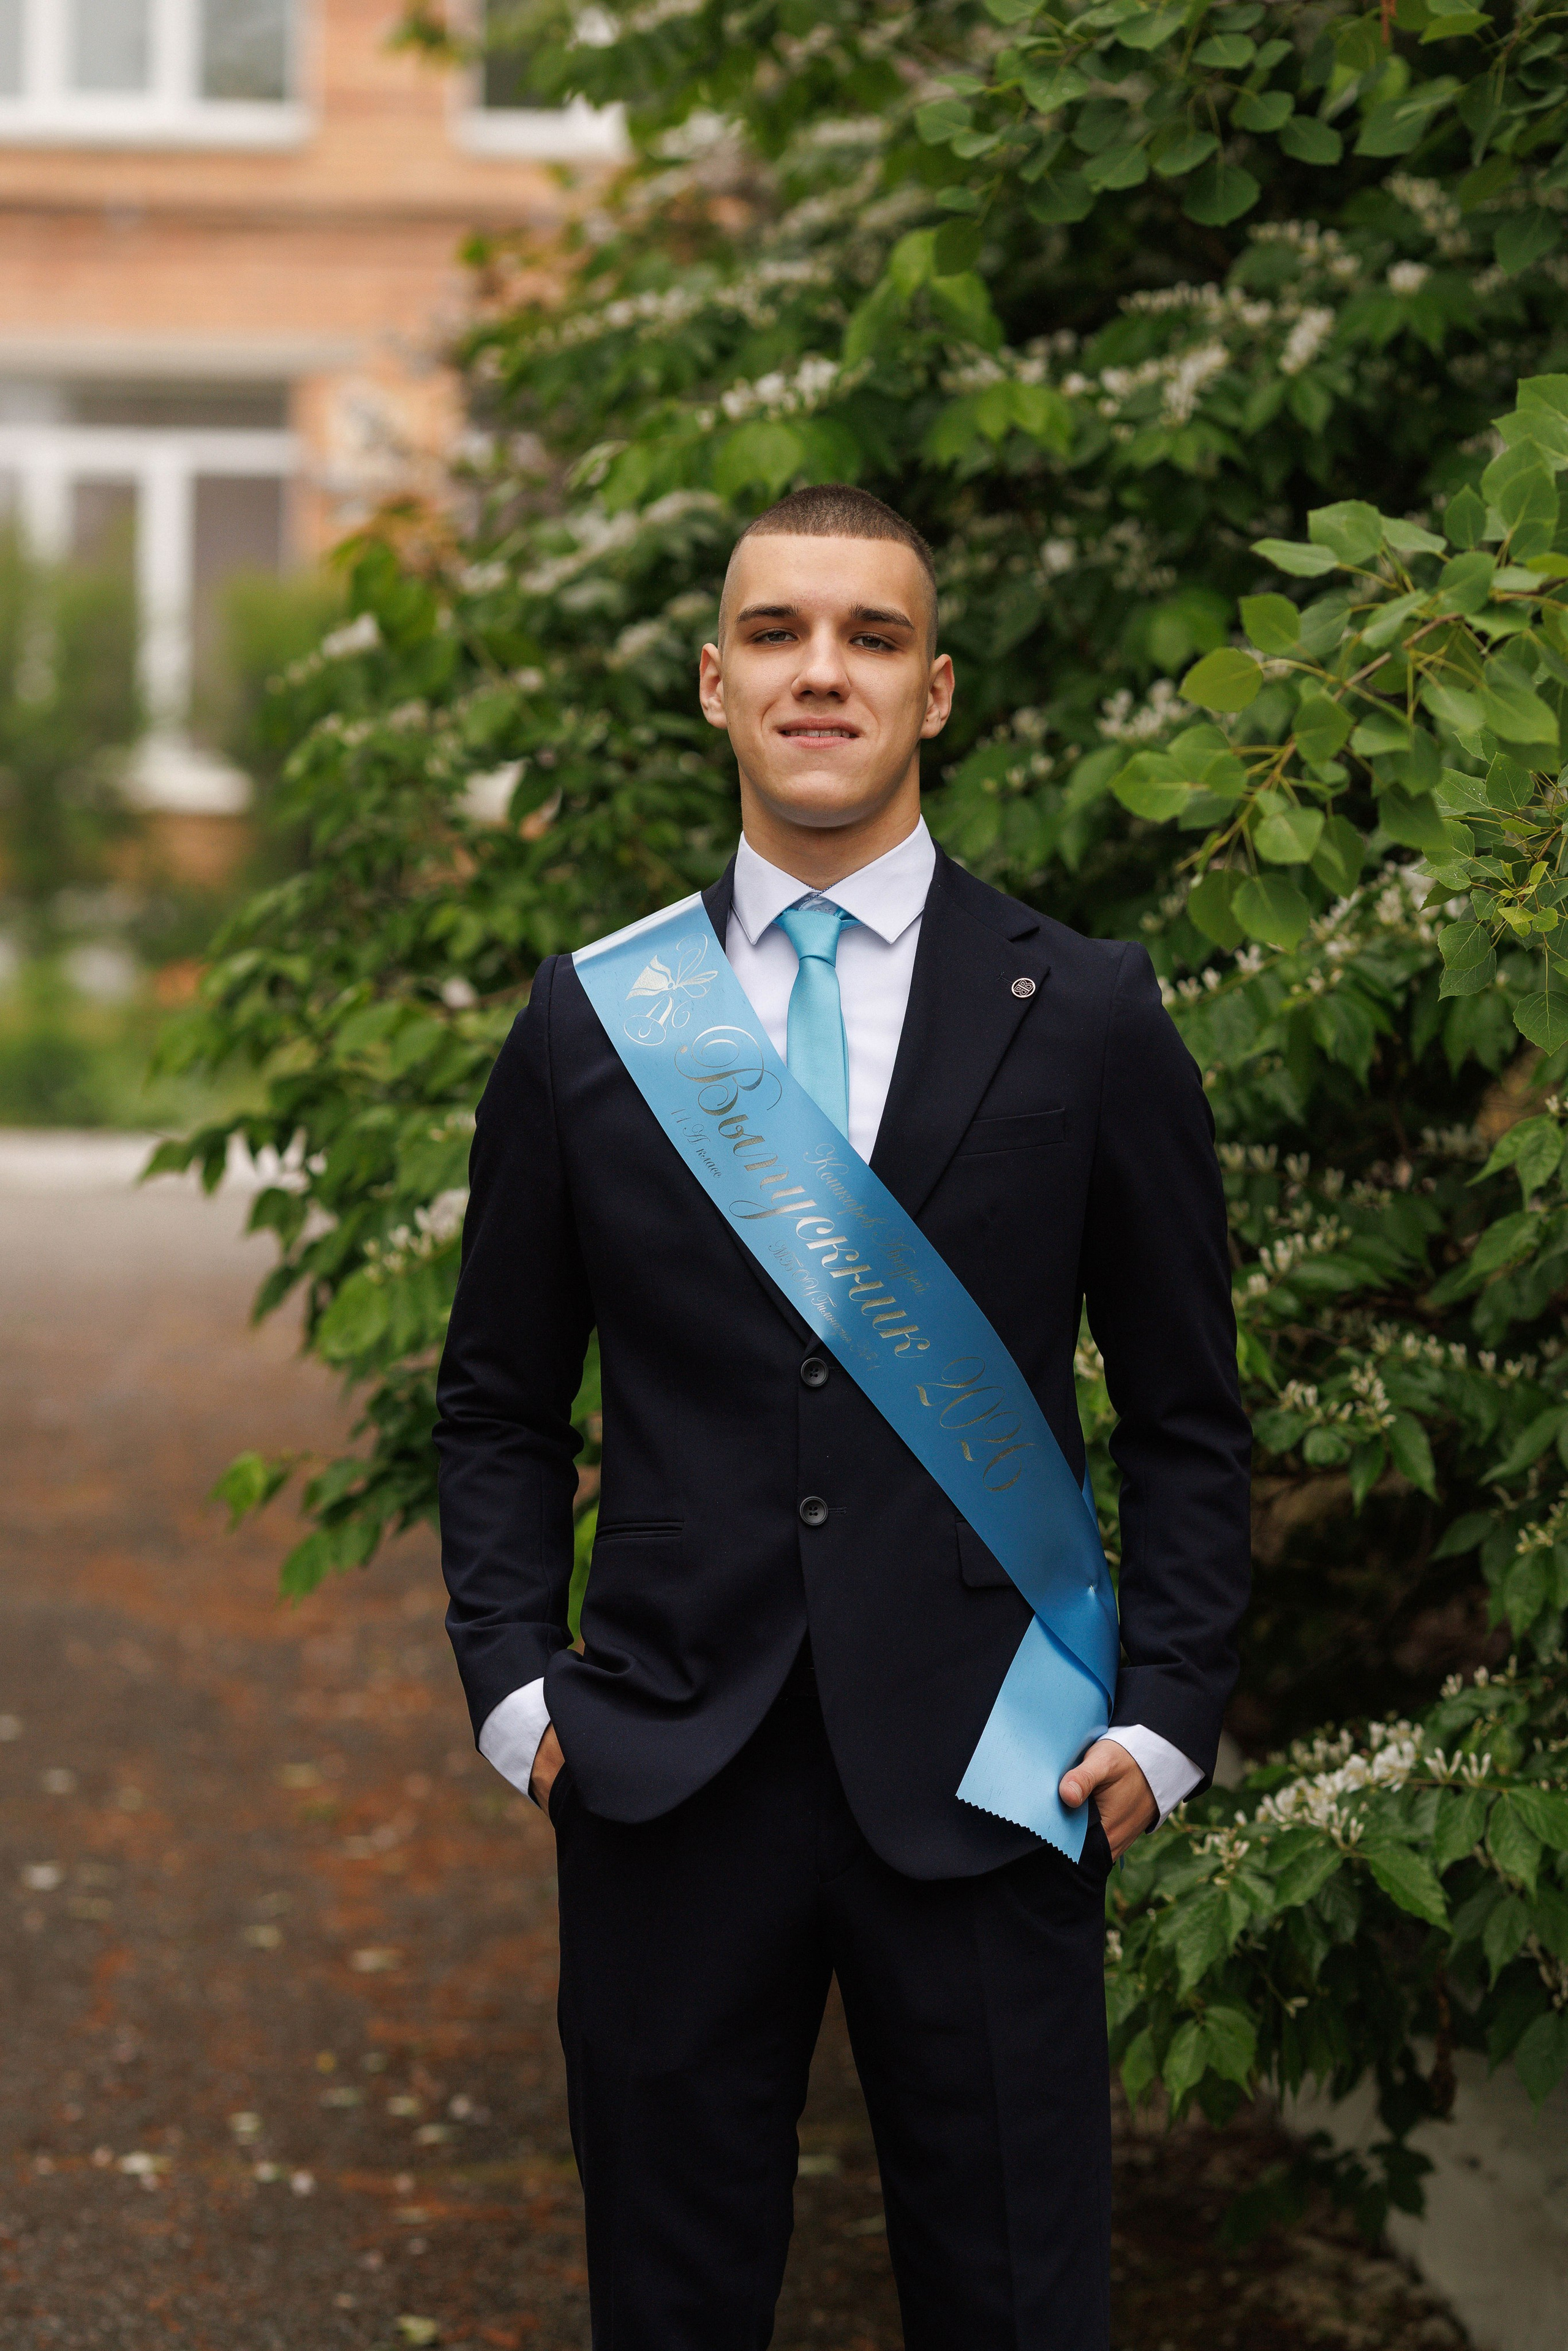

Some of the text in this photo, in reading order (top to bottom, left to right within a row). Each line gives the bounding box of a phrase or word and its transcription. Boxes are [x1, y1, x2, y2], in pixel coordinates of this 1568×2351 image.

[671, 1108, 692, 1123] 11
[696, 1148, 722, 1178] класс
[674, 1025, 1041, 1492] Выпускник 2026
